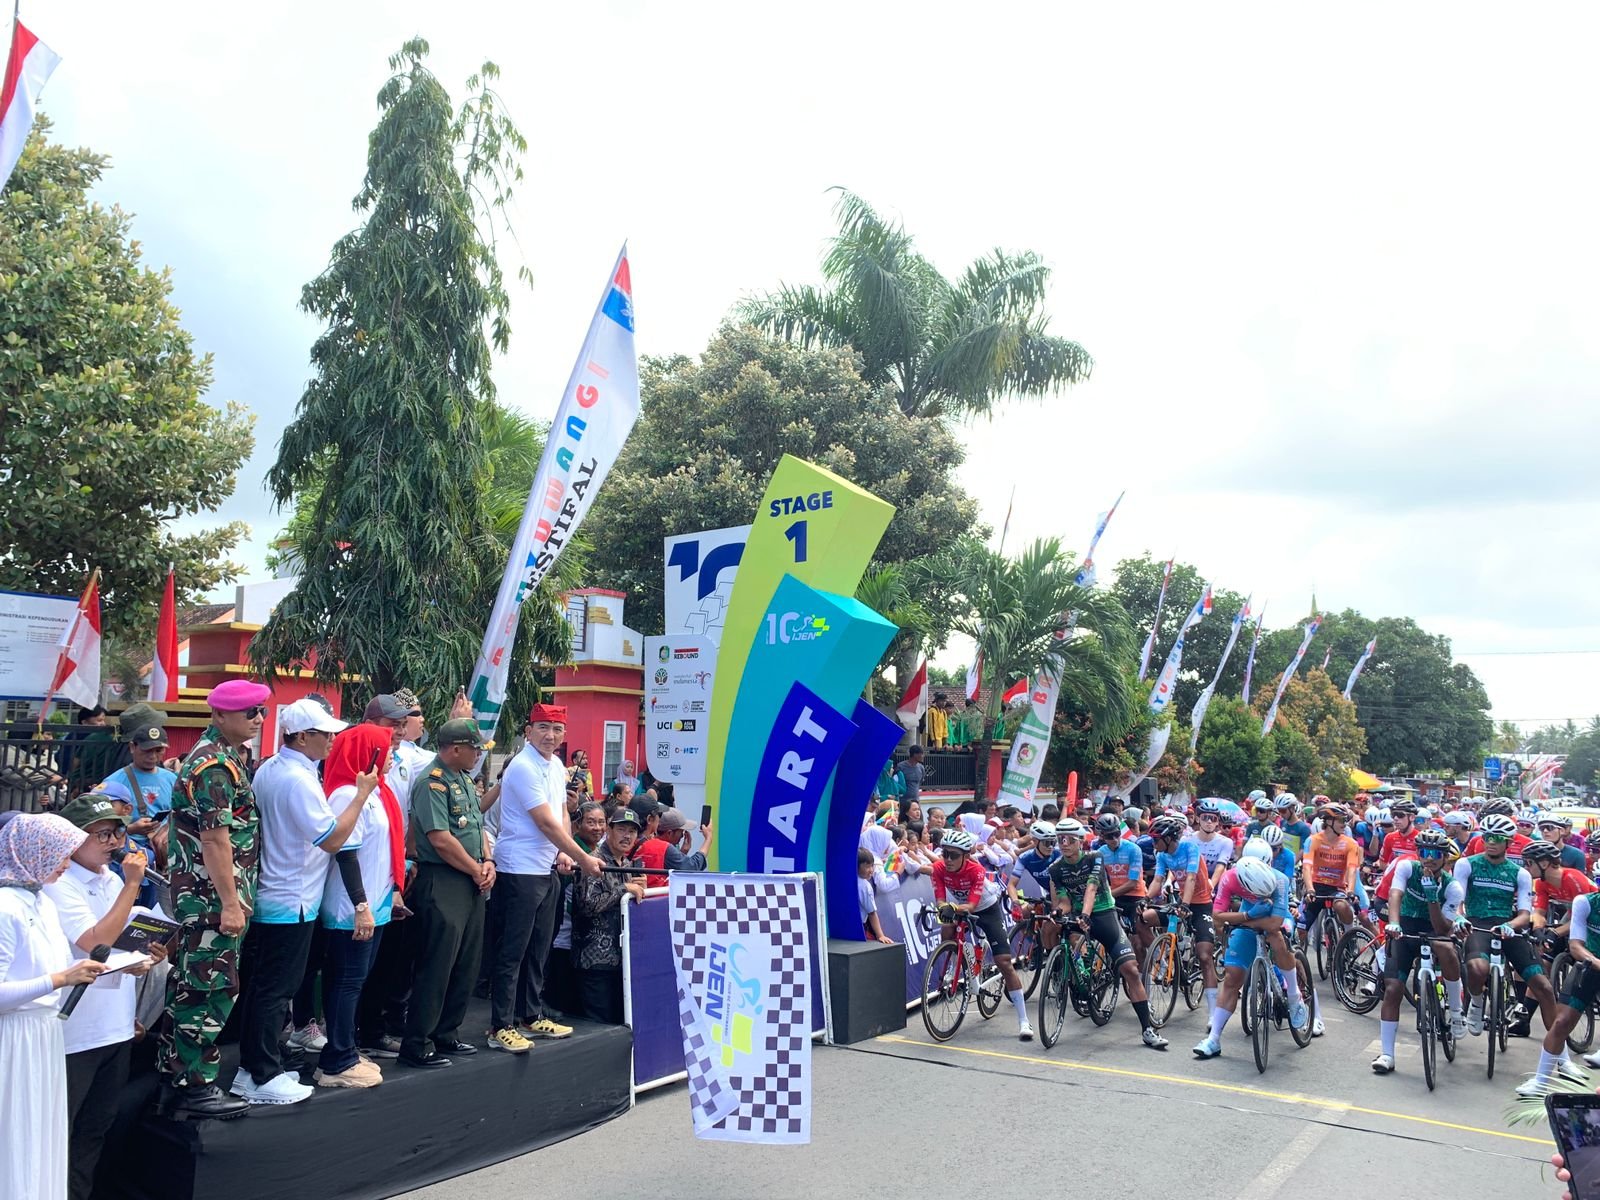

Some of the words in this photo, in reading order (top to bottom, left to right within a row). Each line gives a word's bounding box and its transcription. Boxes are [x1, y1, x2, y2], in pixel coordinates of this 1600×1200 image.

[770, 490, 833, 517] STAGE
[519, 457, 599, 603] ESTIFAL
[784, 520, 807, 563] 1
[792, 632, 817, 641] IJEN
[657, 722, 672, 730] UCI
[763, 705, 828, 874] TART
[1492, 879, 1514, 887] CYCLING
[705, 943, 726, 1019] IJEN
